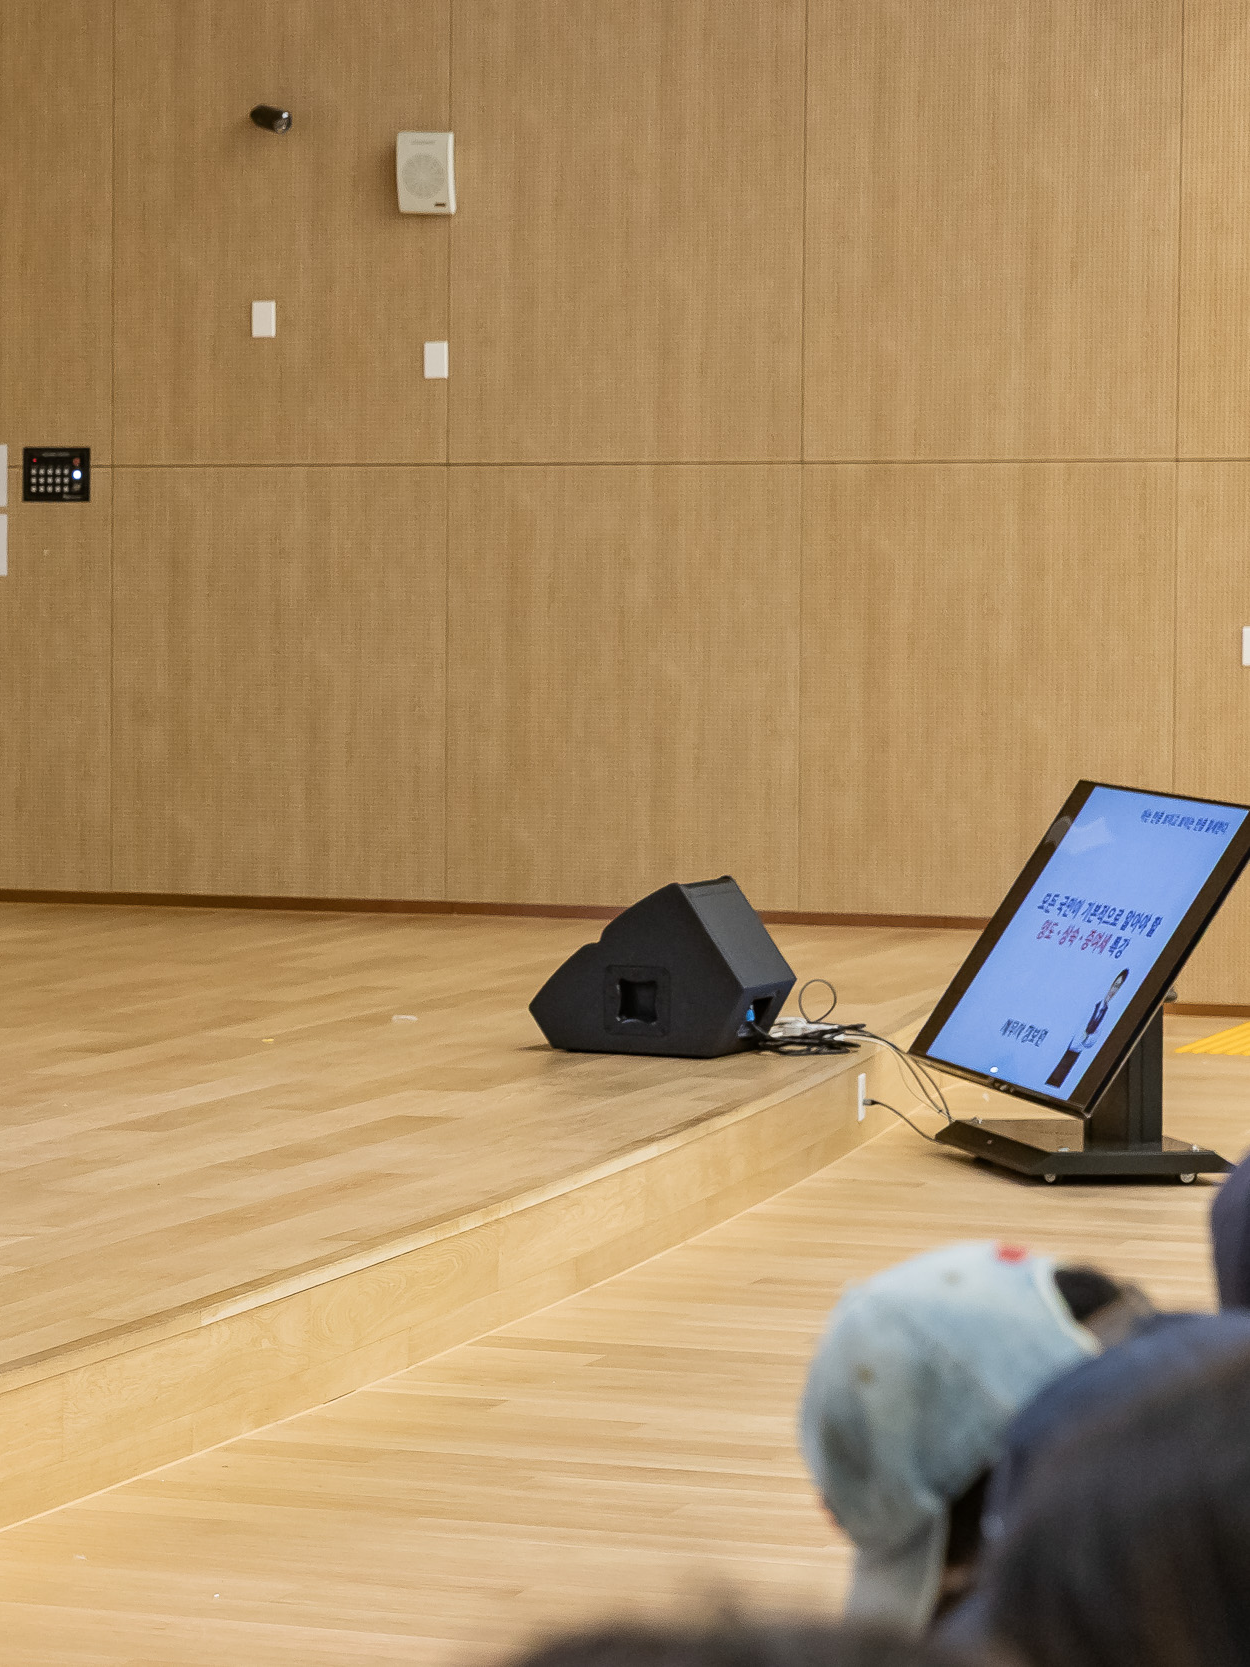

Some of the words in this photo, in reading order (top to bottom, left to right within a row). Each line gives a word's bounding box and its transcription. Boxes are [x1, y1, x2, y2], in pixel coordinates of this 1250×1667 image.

[1037, 893, 1060, 914] 모든
[1056, 895, 1086, 920] 국민이
[1081, 901, 1125, 926] 기본적으로
[1119, 910, 1153, 934] 알아야
[1108, 936, 1131, 959] 특강
